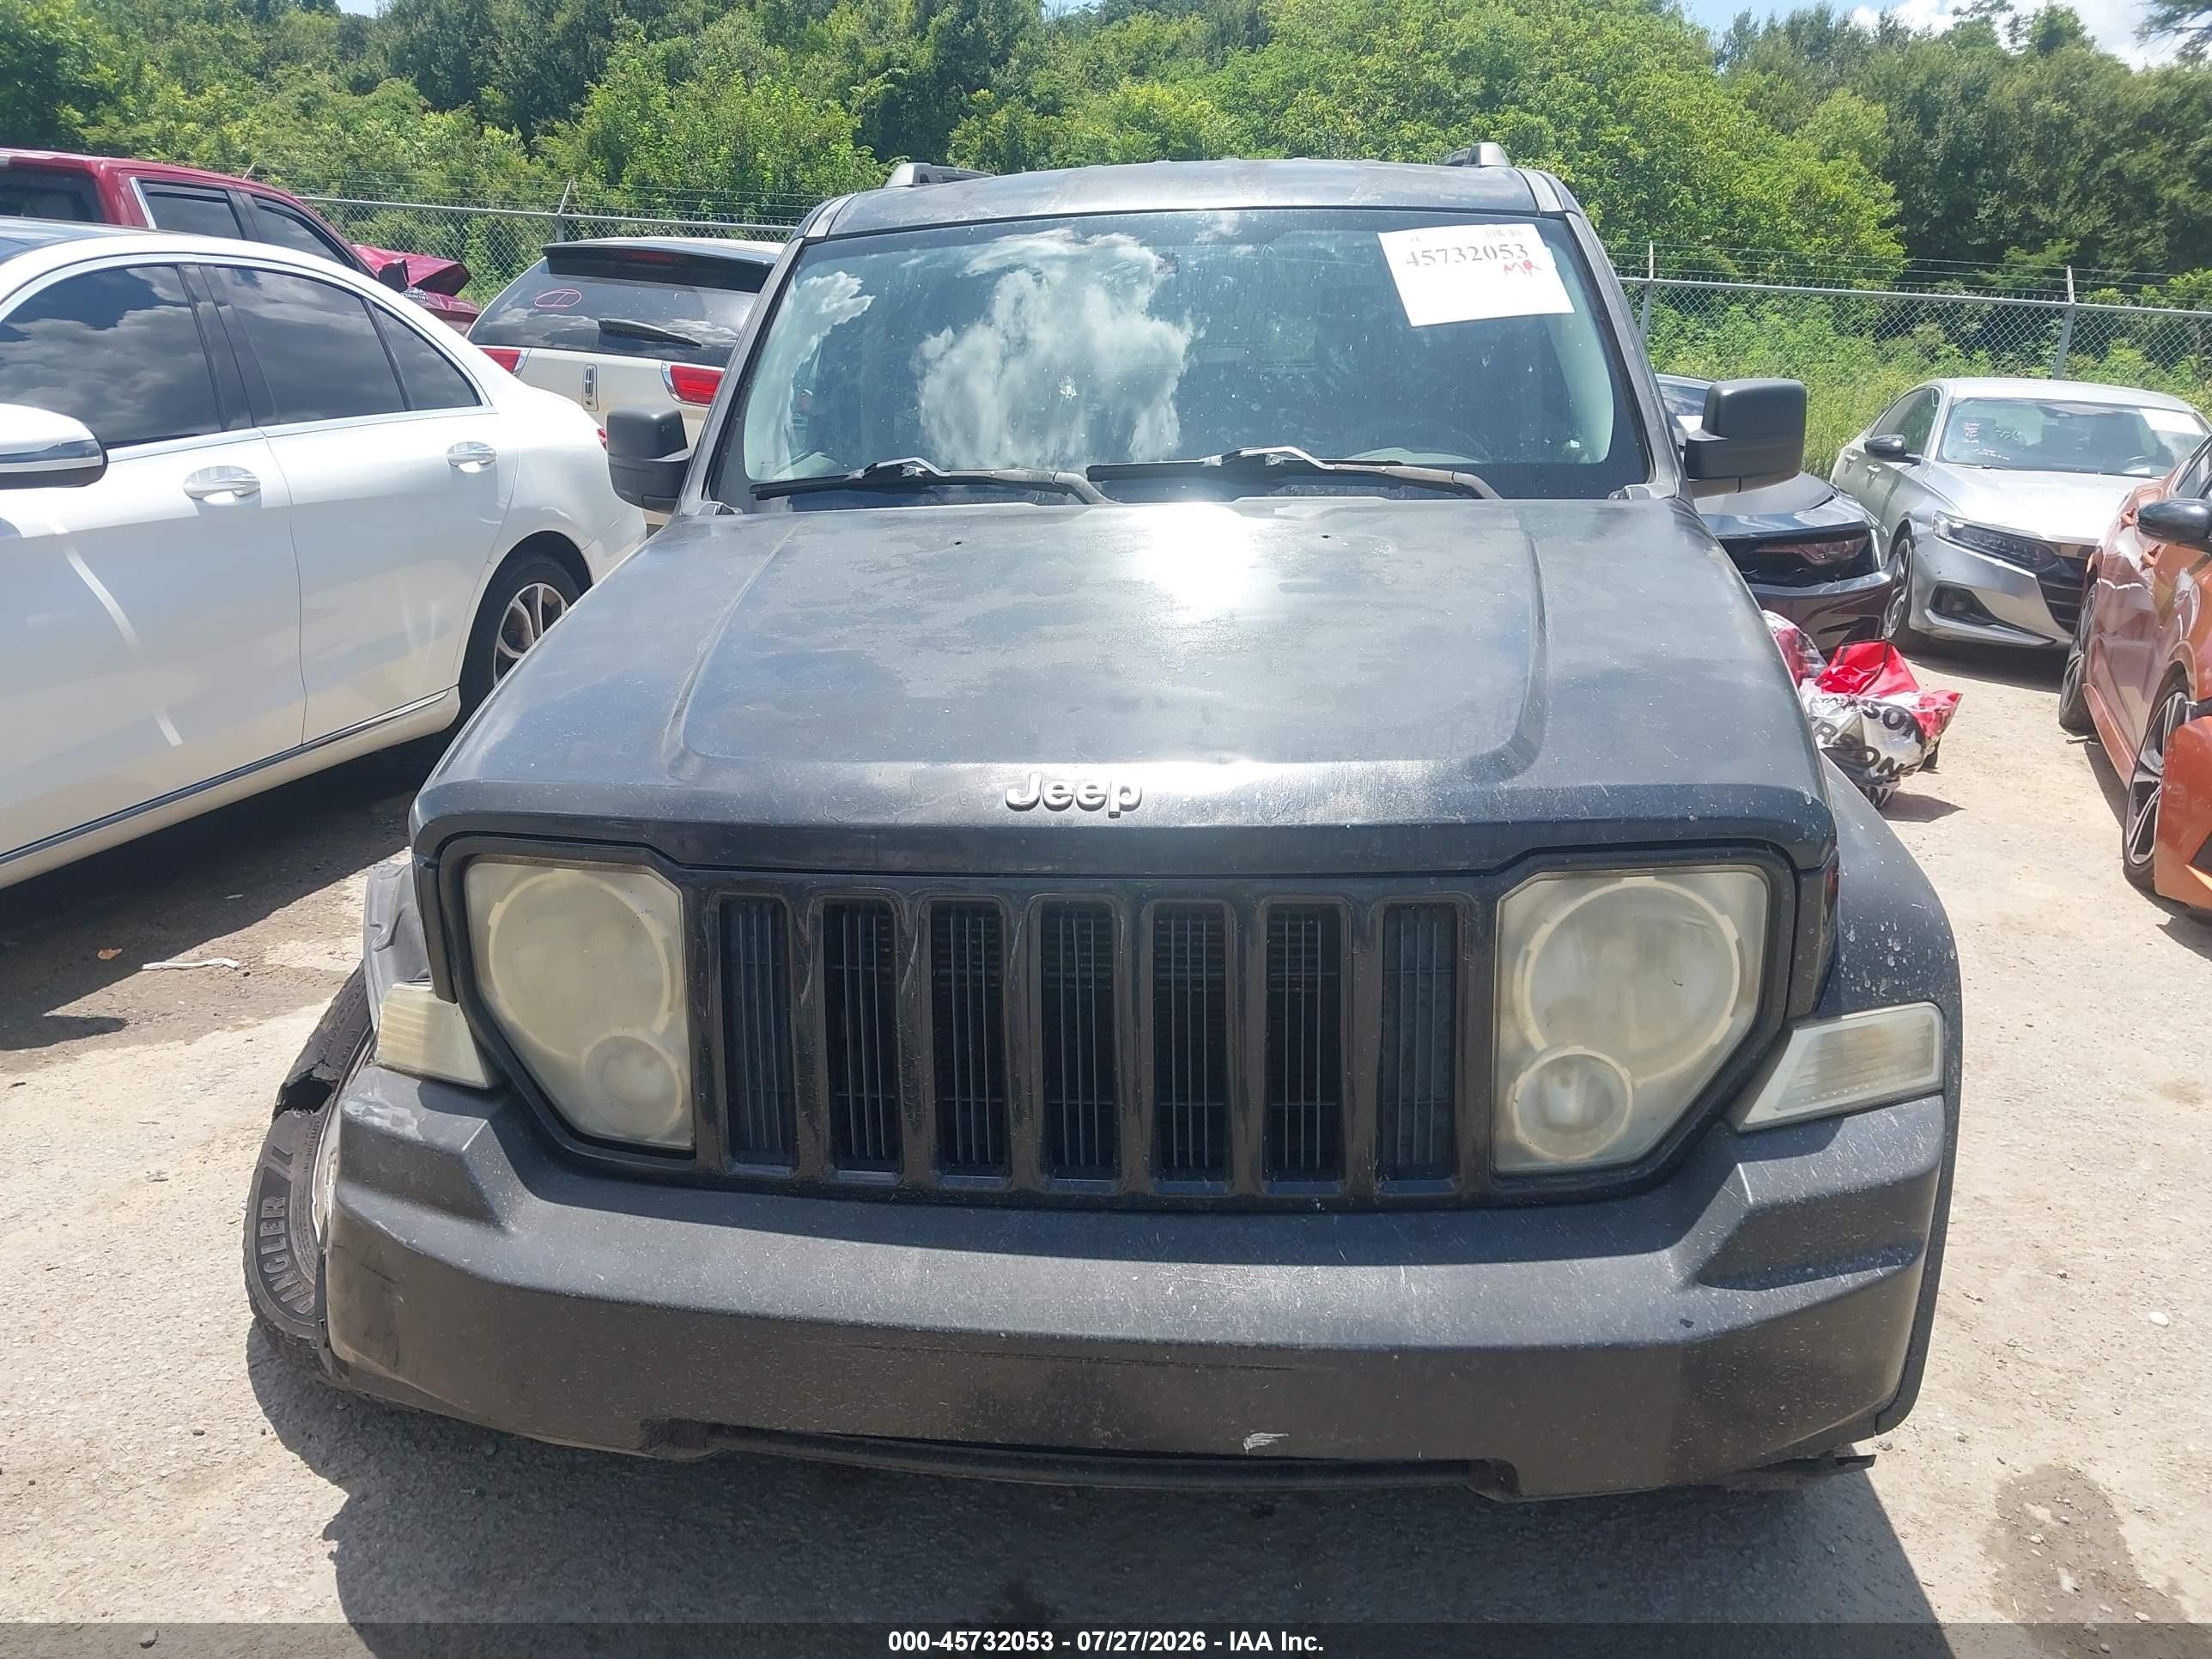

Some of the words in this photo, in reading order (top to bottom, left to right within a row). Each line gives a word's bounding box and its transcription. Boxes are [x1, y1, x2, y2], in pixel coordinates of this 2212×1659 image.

[1406, 244, 1529, 267] 45732053
[1005, 771, 1143, 819] Jeep
[259, 1195, 315, 1316] RANGLER
